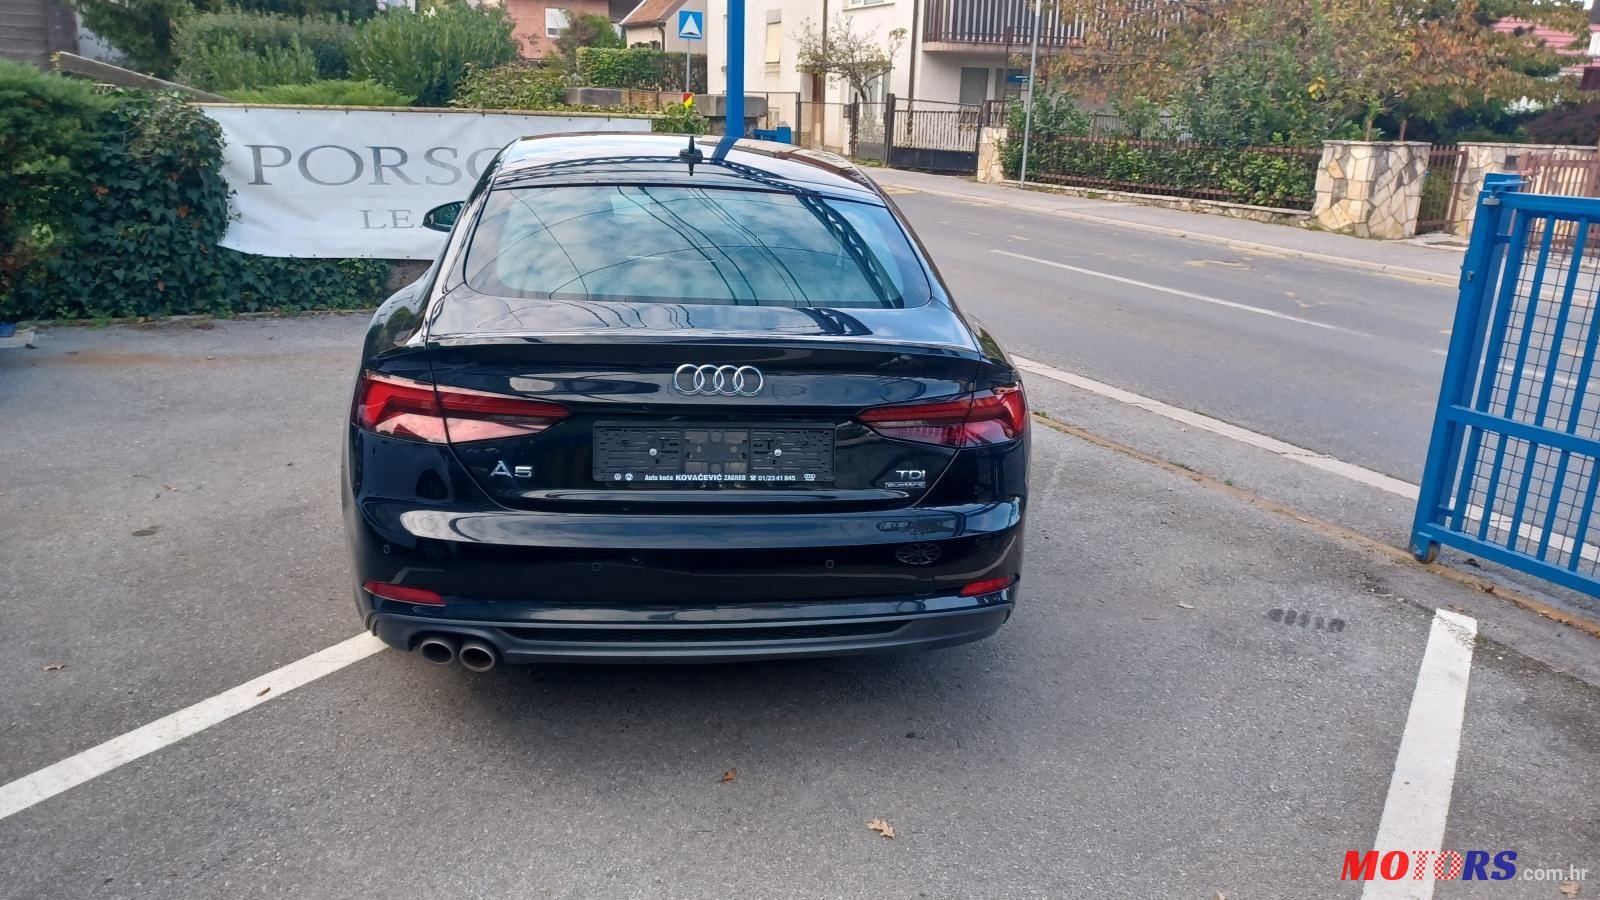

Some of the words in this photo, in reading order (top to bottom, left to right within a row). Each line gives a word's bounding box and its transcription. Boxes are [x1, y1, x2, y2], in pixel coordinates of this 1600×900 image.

[358, 209, 423, 229] LE
[490, 460, 532, 478] A5
[895, 470, 926, 480] TDI
[675, 473, 723, 481] KOVAČEVIĆ
